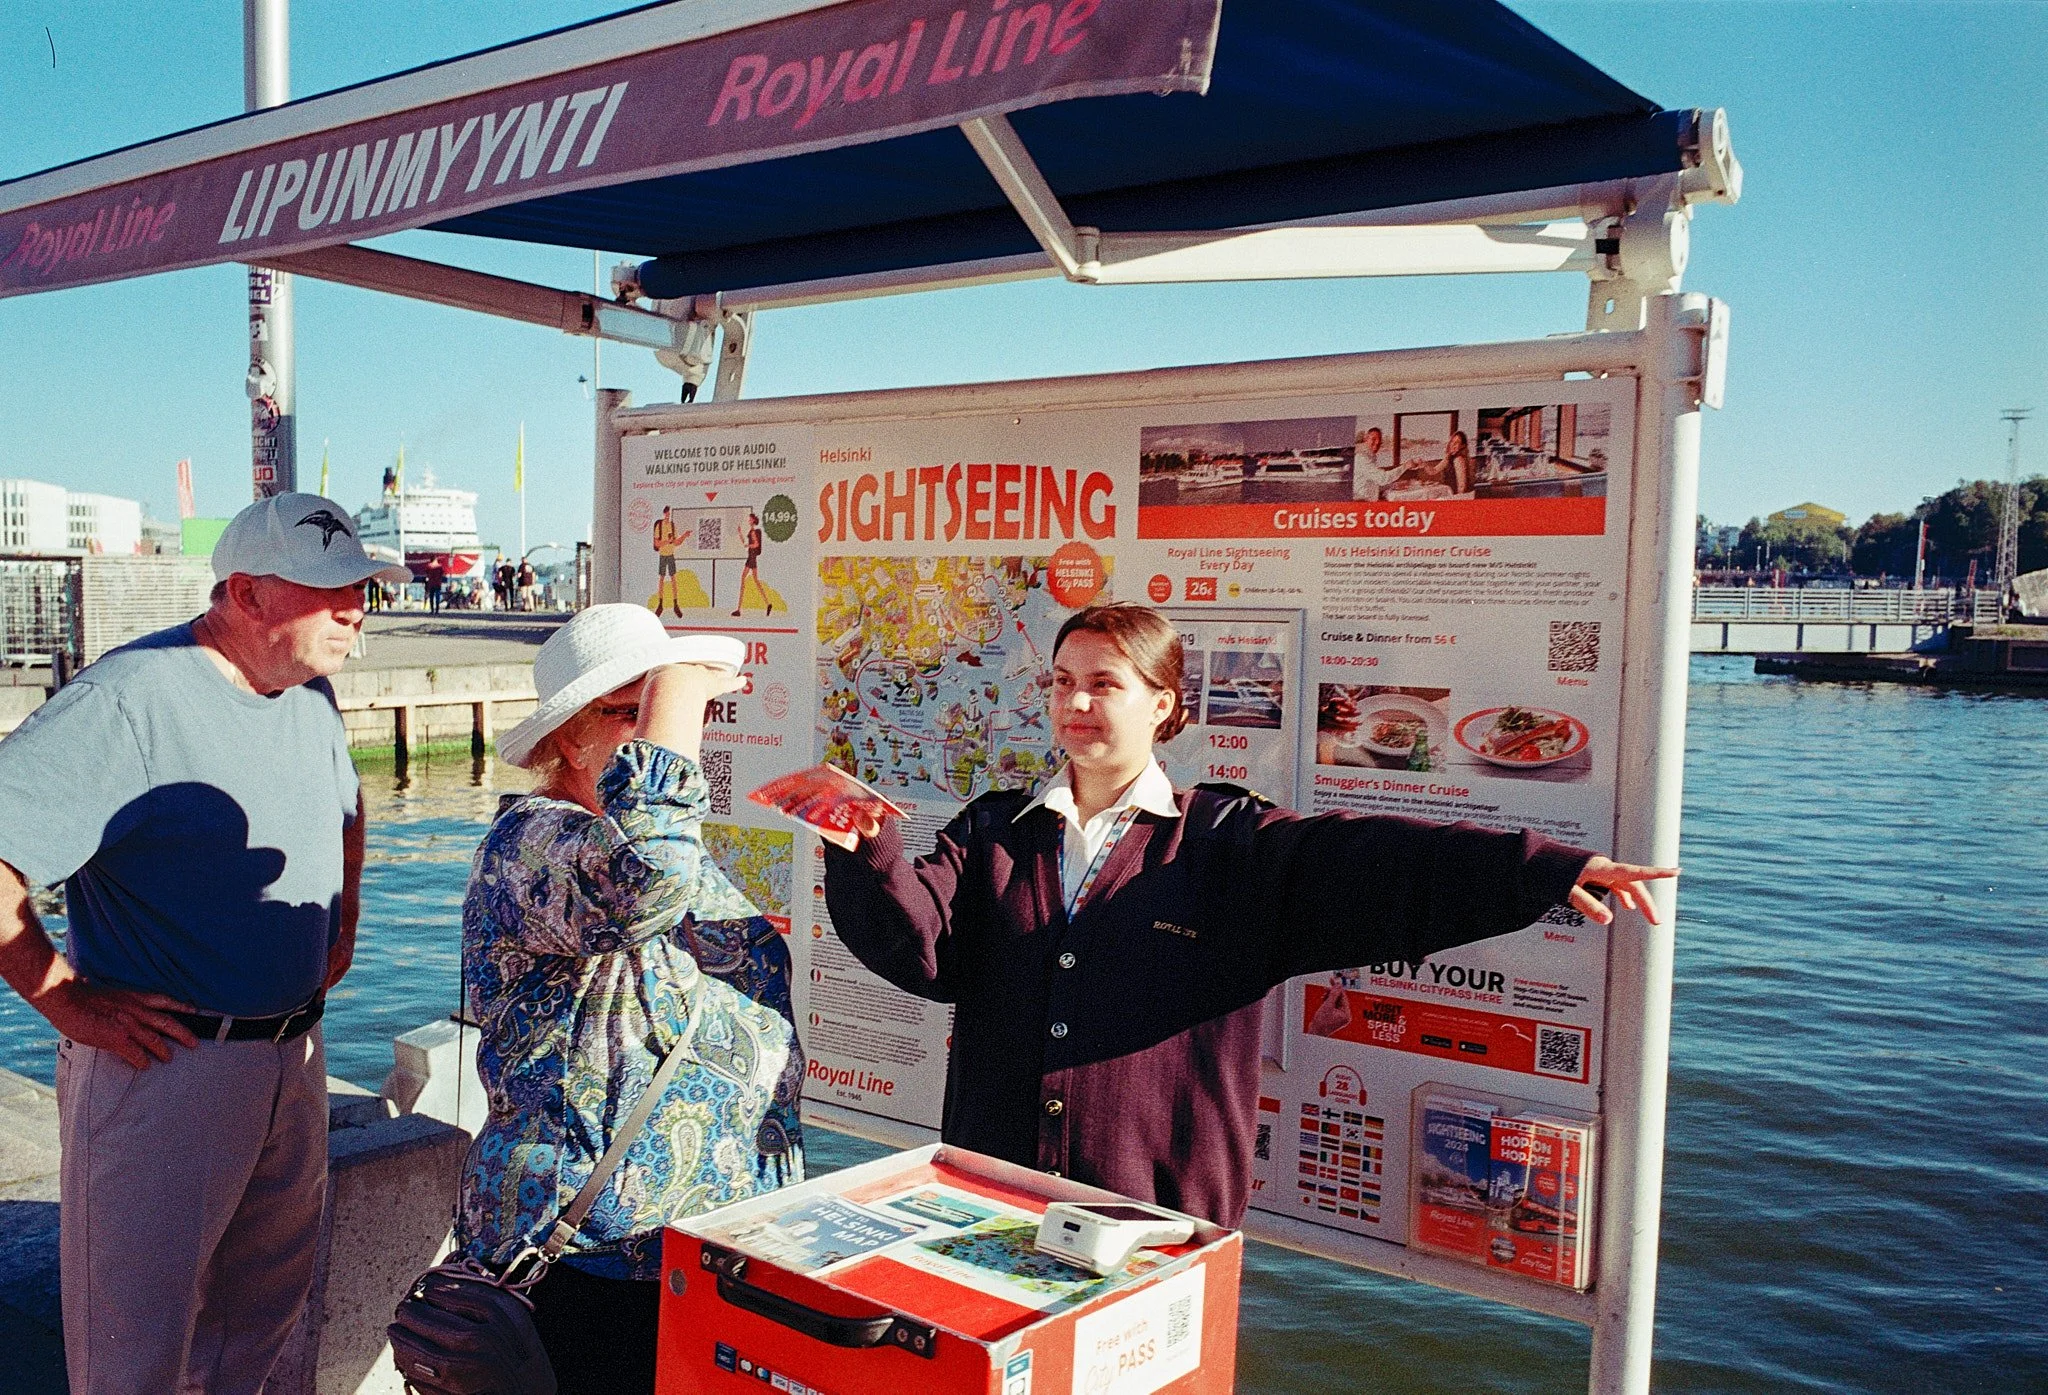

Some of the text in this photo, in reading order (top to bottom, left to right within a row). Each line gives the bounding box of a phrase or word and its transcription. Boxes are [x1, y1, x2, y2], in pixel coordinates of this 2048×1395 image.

[708, 0, 1096, 130] Royal Line
[218, 82, 629, 244] LIPUNMYYNTI
[3, 197, 175, 276] Royal Line
[654, 443, 776, 460] WELCOME TO OUR AUDIO
[820, 446, 872, 463] Helsinki
[645, 457, 786, 475] WALKING TOUR OF HELSINKI!
[818, 462, 1117, 543] SIGHTSEEING
[1273, 506, 1436, 534] Cruises today
[1167, 547, 1291, 561] Royal Line Sightseeing
[1324, 546, 1491, 557] M/s Helsinki Dinner Cruise
[1200, 560, 1254, 573] Every Day
[1072, 578, 1094, 588] PASS
[1321, 632, 1353, 642] Cruise
[1355, 632, 1364, 642] &
[1367, 633, 1402, 643] Dinner
[1405, 634, 1431, 643] from
[1557, 676, 1589, 687] Menu
[702, 730, 783, 747] without meals!
[1208, 734, 1248, 749] 12:00
[1208, 764, 1248, 779] 14:00
[1314, 774, 1470, 797] Smuggler's Dinner Cruise
[896, 801, 917, 811] more
[1543, 931, 1575, 943] Menu
[1430, 962, 1505, 993] YOUR
[1370, 976, 1503, 1004] HELSINKI CITYPASS HERE
[1373, 1001, 1403, 1014] VISIT
[1363, 1009, 1397, 1023] MORE
[1398, 1015, 1407, 1025] &
[1367, 1020, 1406, 1034] SPEND
[1372, 1030, 1400, 1043] LESS
[807, 1059, 895, 1096] Royal Line
[1444, 1138, 1469, 1151] 2024
[811, 1206, 898, 1241] HELSINKI
[1430, 1210, 1456, 1224] Royal
[831, 1231, 880, 1247] MAP
[1118, 1338, 1156, 1376] PASS
